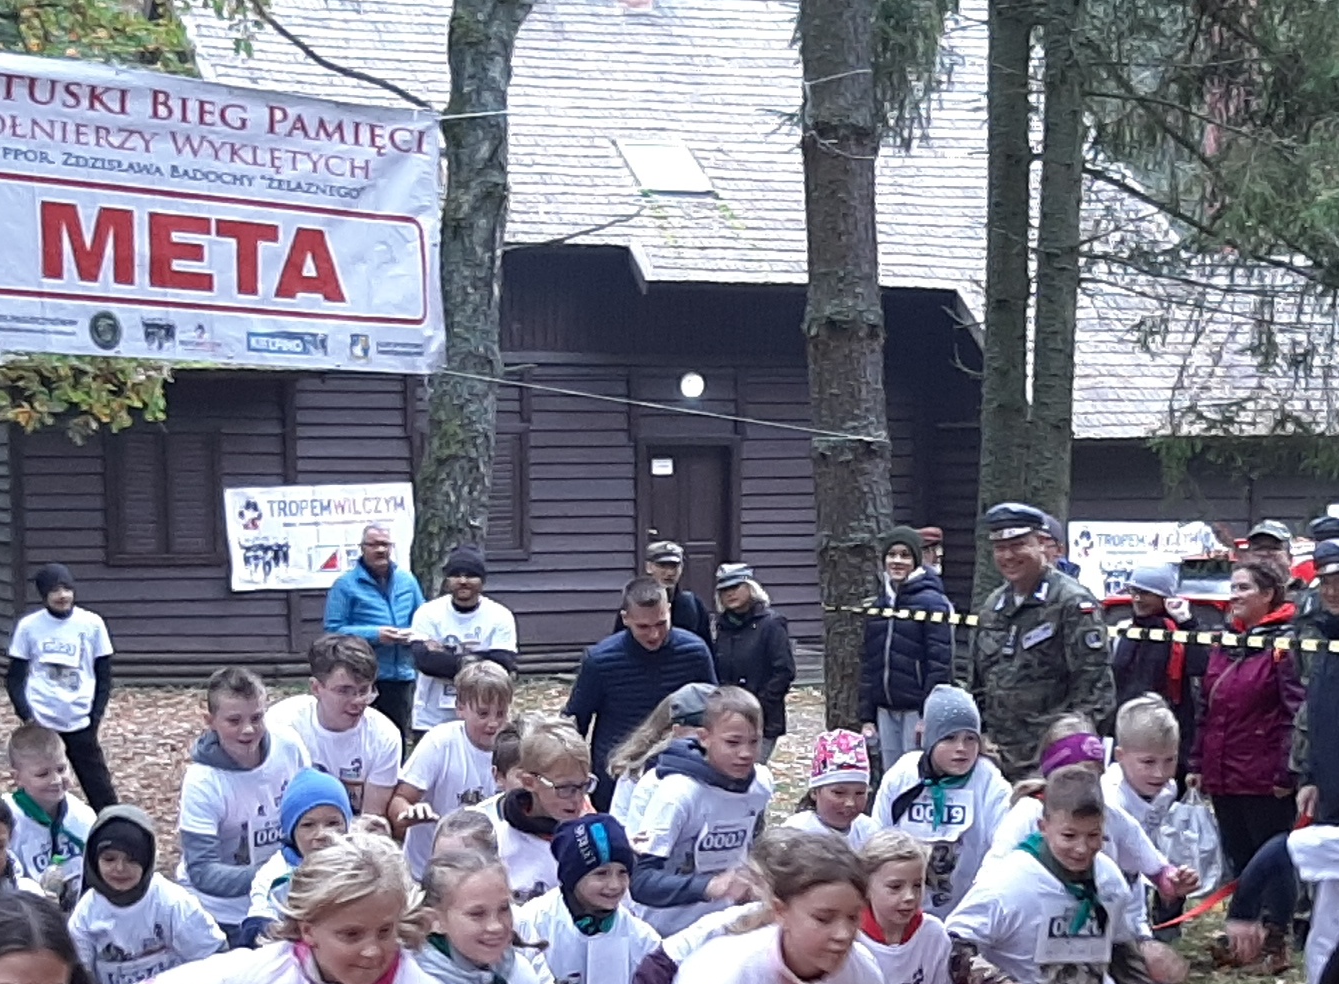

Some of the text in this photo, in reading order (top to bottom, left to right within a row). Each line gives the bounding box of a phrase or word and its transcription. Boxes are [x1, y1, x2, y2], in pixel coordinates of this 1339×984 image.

[148, 88, 248, 131] BIEG
[266, 103, 428, 157] PAMIĘCI
[62, 152, 164, 177] ZDZISŁAWA
[170, 164, 254, 187] BADOCHY
[169, 129, 372, 181] WYKLĘTYCH
[40, 200, 347, 304] META
